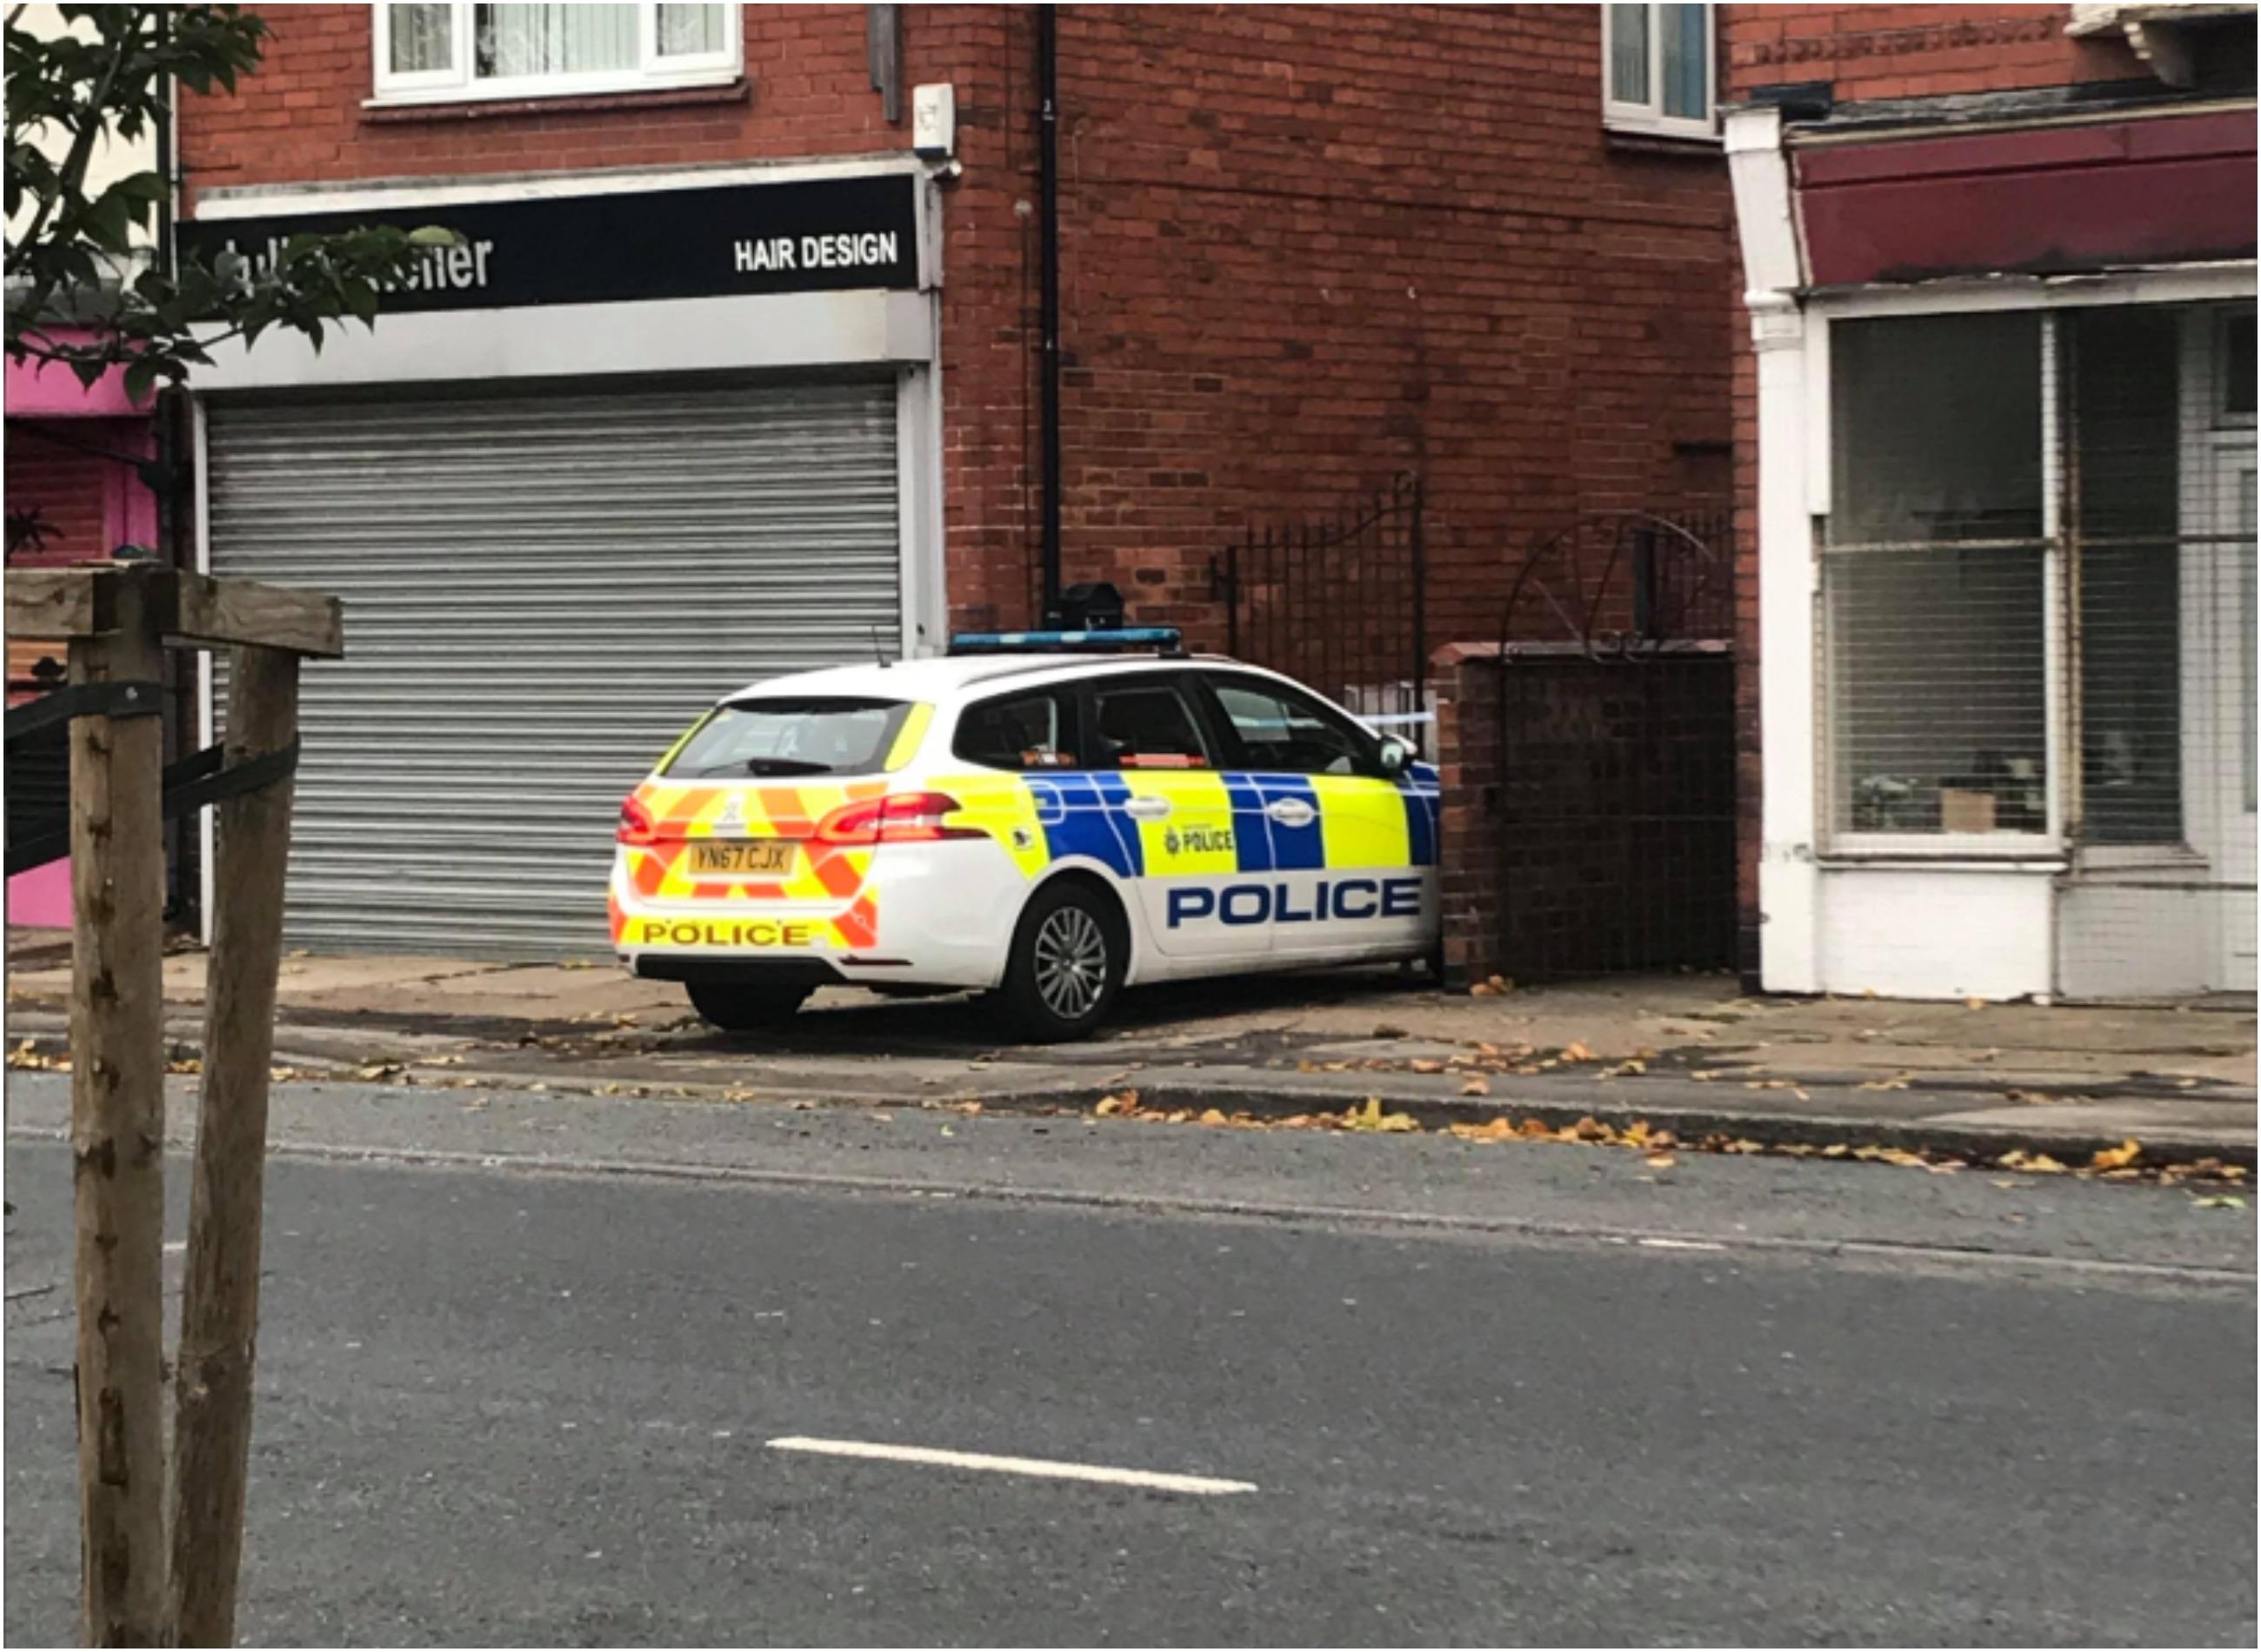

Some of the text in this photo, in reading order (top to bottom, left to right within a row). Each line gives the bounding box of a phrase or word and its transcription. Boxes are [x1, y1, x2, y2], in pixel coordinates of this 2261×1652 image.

[734, 230, 897, 272] HAIR DESIGN
[1183, 829, 1233, 853] POLICE
[1166, 878, 1424, 929] POLICE
[642, 922, 810, 946] POLICE
